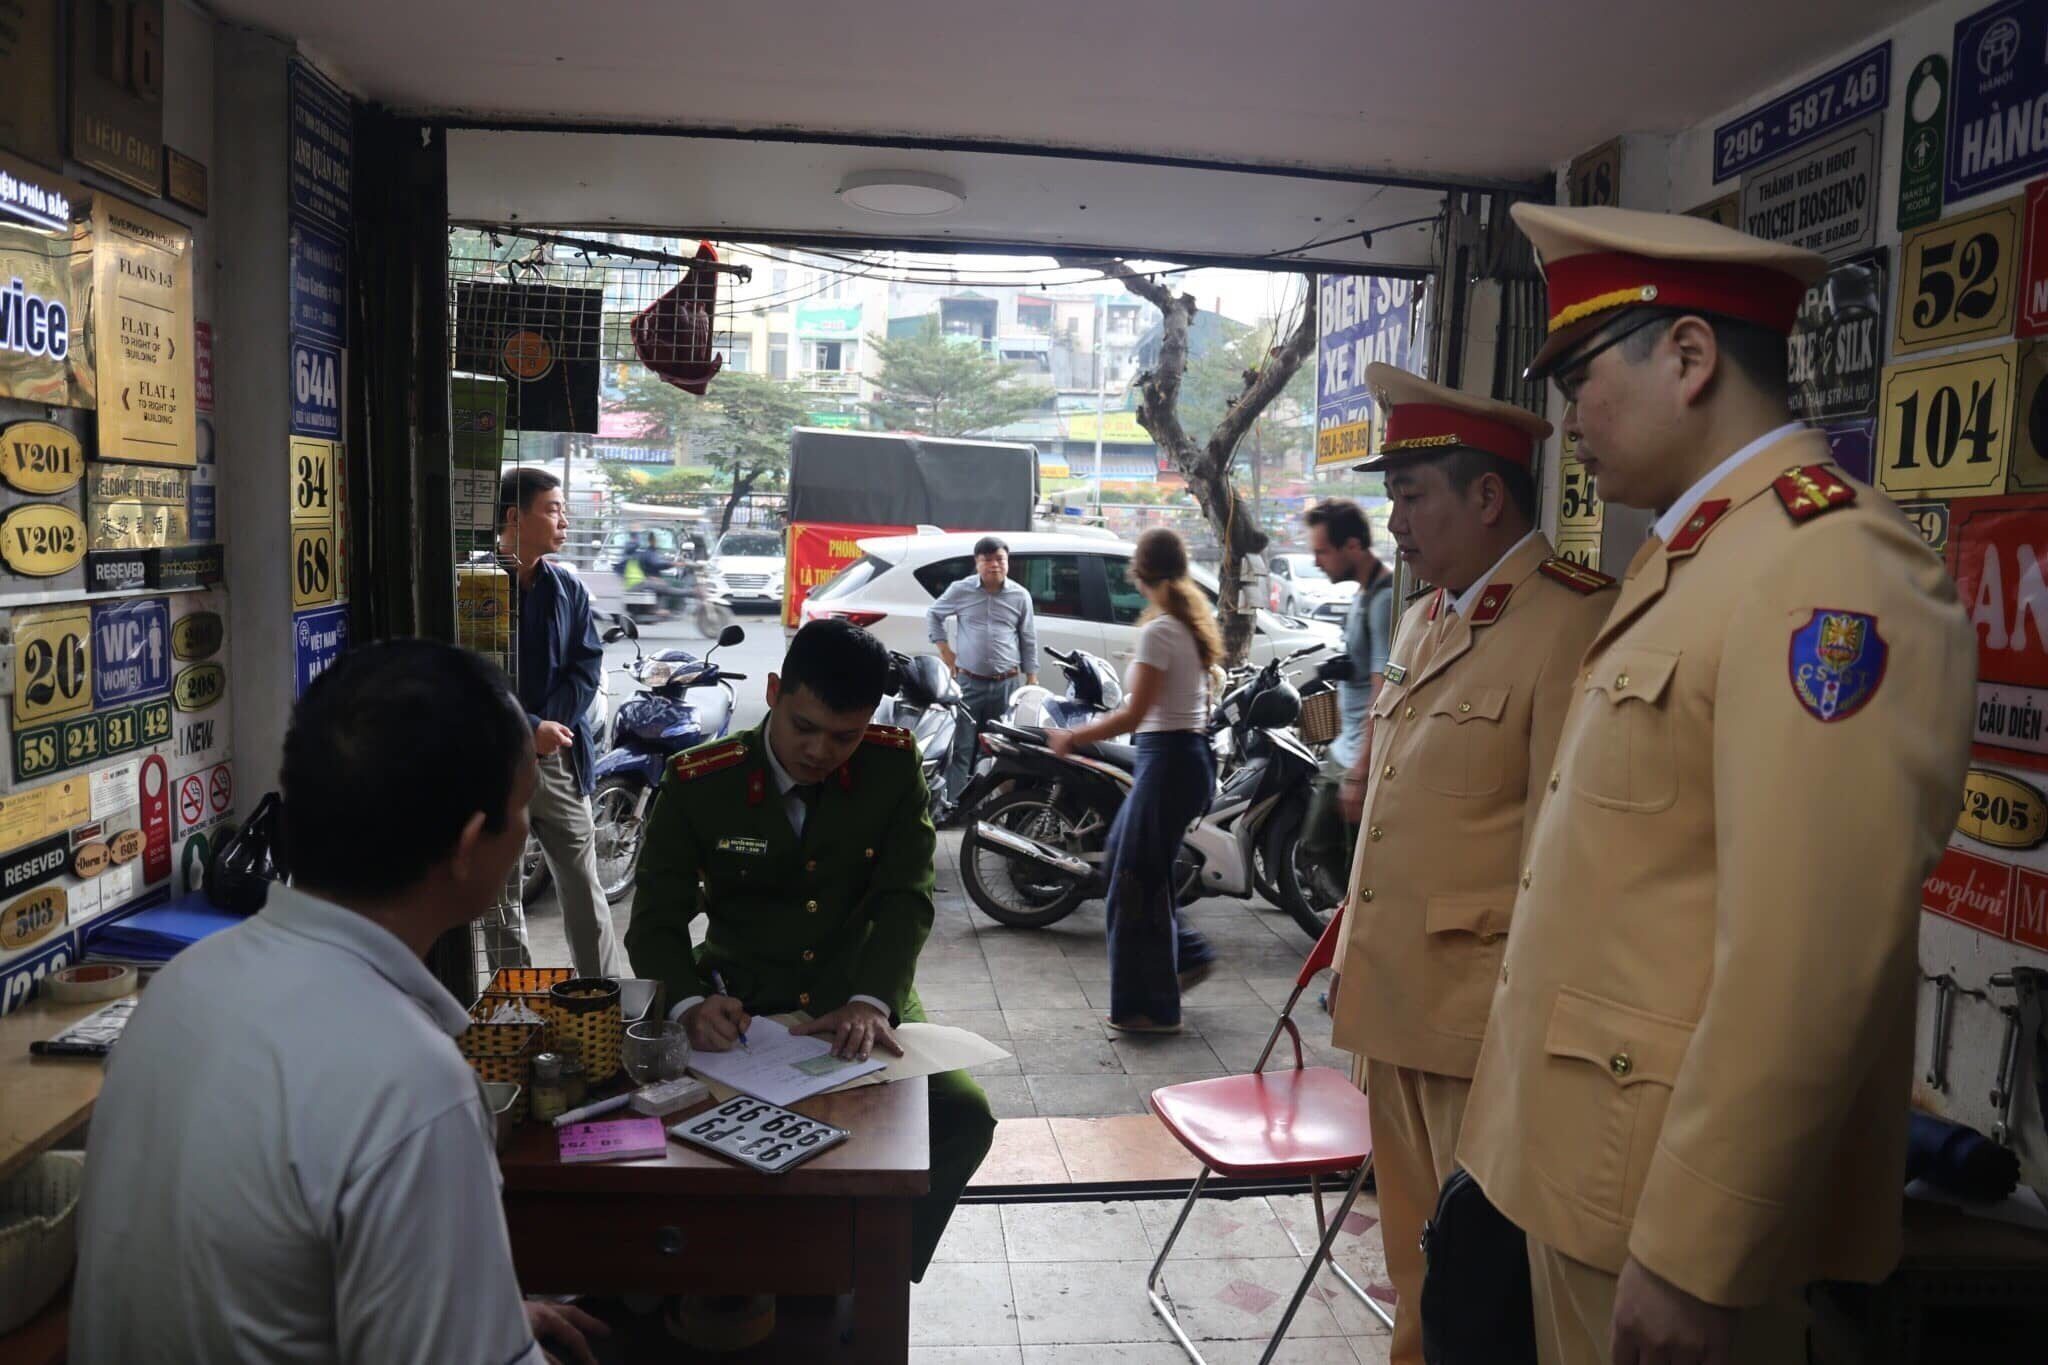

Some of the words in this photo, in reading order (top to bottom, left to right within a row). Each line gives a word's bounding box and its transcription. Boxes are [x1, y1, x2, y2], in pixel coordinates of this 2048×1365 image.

[1722, 121, 1764, 169] 29C
[1788, 63, 1878, 137] 587.46
[1748, 200, 1795, 241] YOICHI
[1798, 173, 1866, 230] HOSHINO
[119, 257, 156, 286] FLATS
[1912, 232, 2000, 329] 52
[1796, 276, 1836, 322] PA
[121, 315, 152, 338] FLAT
[152, 325, 160, 340] 4
[1835, 318, 1873, 375] SILK
[139, 380, 168, 399] FLAT
[169, 387, 176, 400] 4
[295, 349, 337, 409] 64A
[1324, 343, 1350, 397] XE
[1891, 377, 1999, 469] 104
[13, 441, 73, 474] V201
[298, 455, 328, 509] 34
[1562, 471, 1599, 519] 54
[16, 524, 76, 556] V202
[828, 535, 863, 559] PHÒNG
[297, 537, 330, 596] 68
[102, 620, 142, 664] WC
[24, 633, 85, 710] 20
[103, 665, 141, 692] WOMEN
[23, 735, 56, 771] 58
[68, 725, 98, 758] 24
[108, 715, 135, 747] 31
[144, 707, 168, 737] 42
[4, 848, 65, 887] RESEVED
[1923, 868, 2004, 917] orghini
